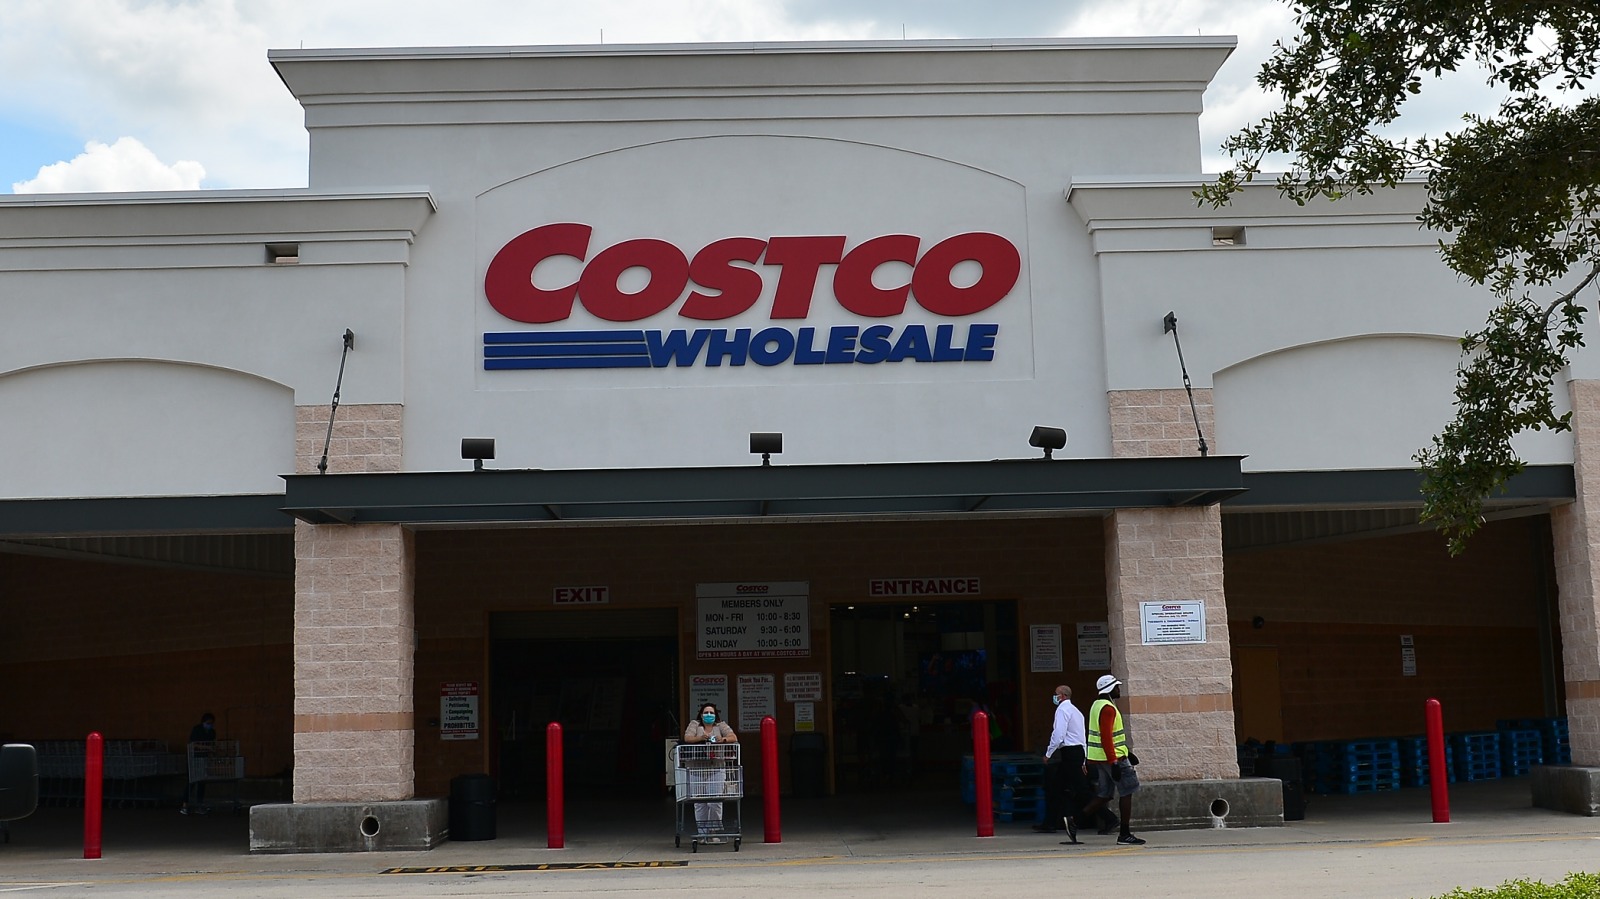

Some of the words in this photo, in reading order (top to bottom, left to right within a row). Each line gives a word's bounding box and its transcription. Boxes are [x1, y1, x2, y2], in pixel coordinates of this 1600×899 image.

[484, 222, 1021, 324] COSTCO
[645, 323, 998, 368] WHOLESALE
[870, 580, 980, 596] ENTRANCE
[555, 588, 606, 603] EXIT
[722, 600, 761, 608] MEMBERS
[706, 614, 724, 622] MON
[706, 626, 747, 635] SATURDAY
[706, 640, 738, 648] SUNDAY
